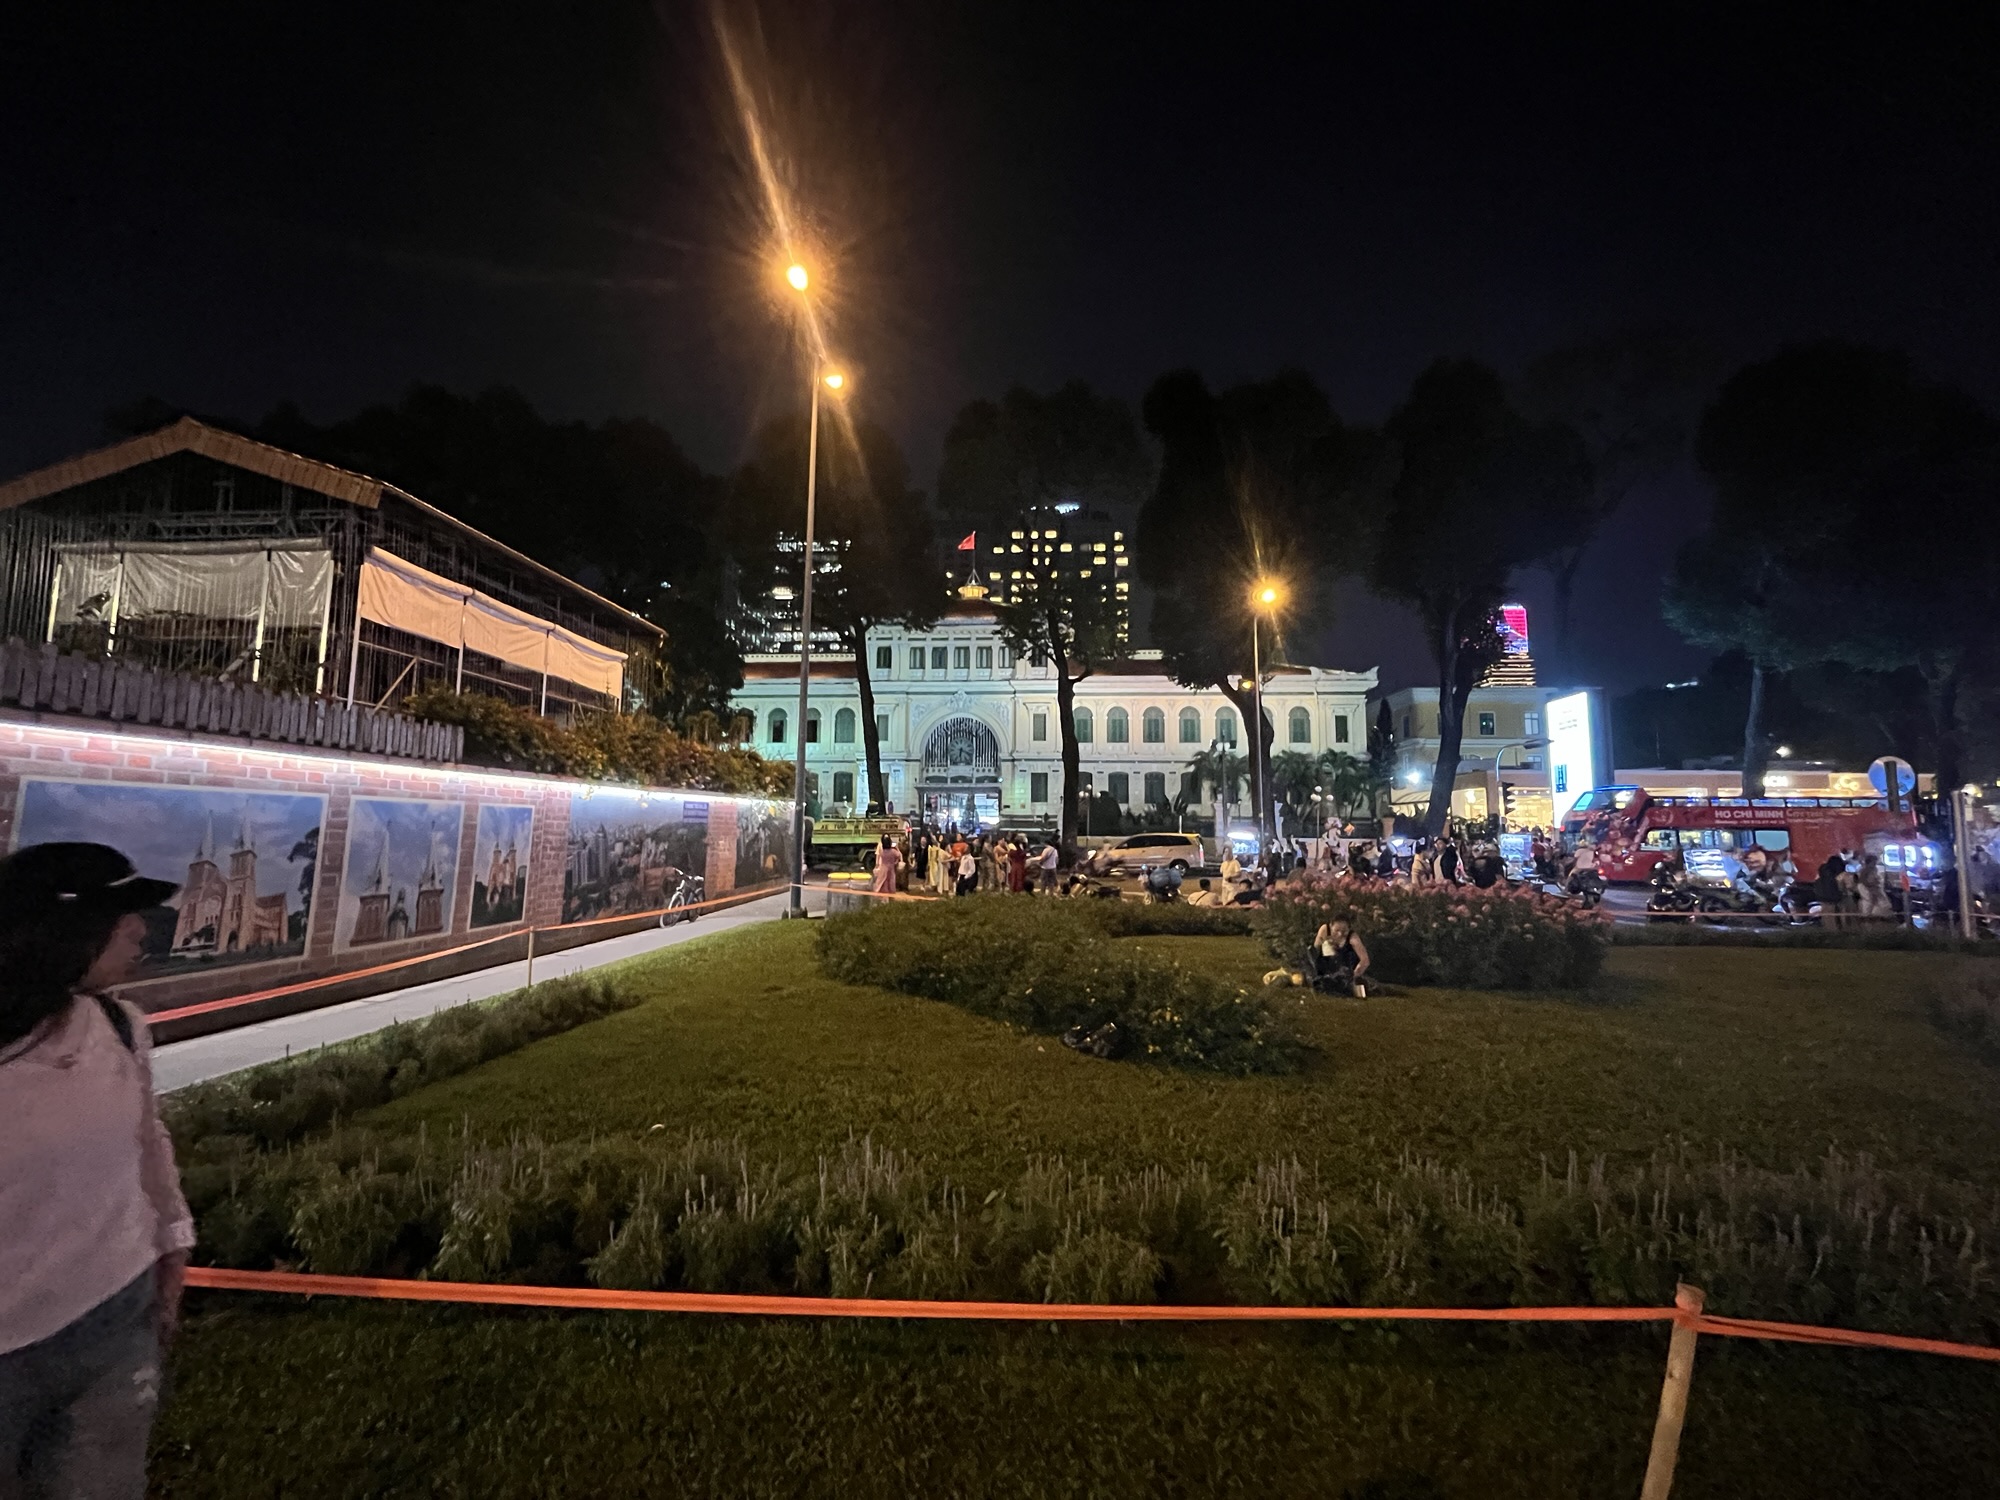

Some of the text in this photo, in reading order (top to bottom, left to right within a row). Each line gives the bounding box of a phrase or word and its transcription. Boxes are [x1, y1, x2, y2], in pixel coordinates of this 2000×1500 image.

[1714, 810, 1731, 818] HO
[1734, 810, 1753, 818] CHI
[1755, 810, 1784, 818] MINH
